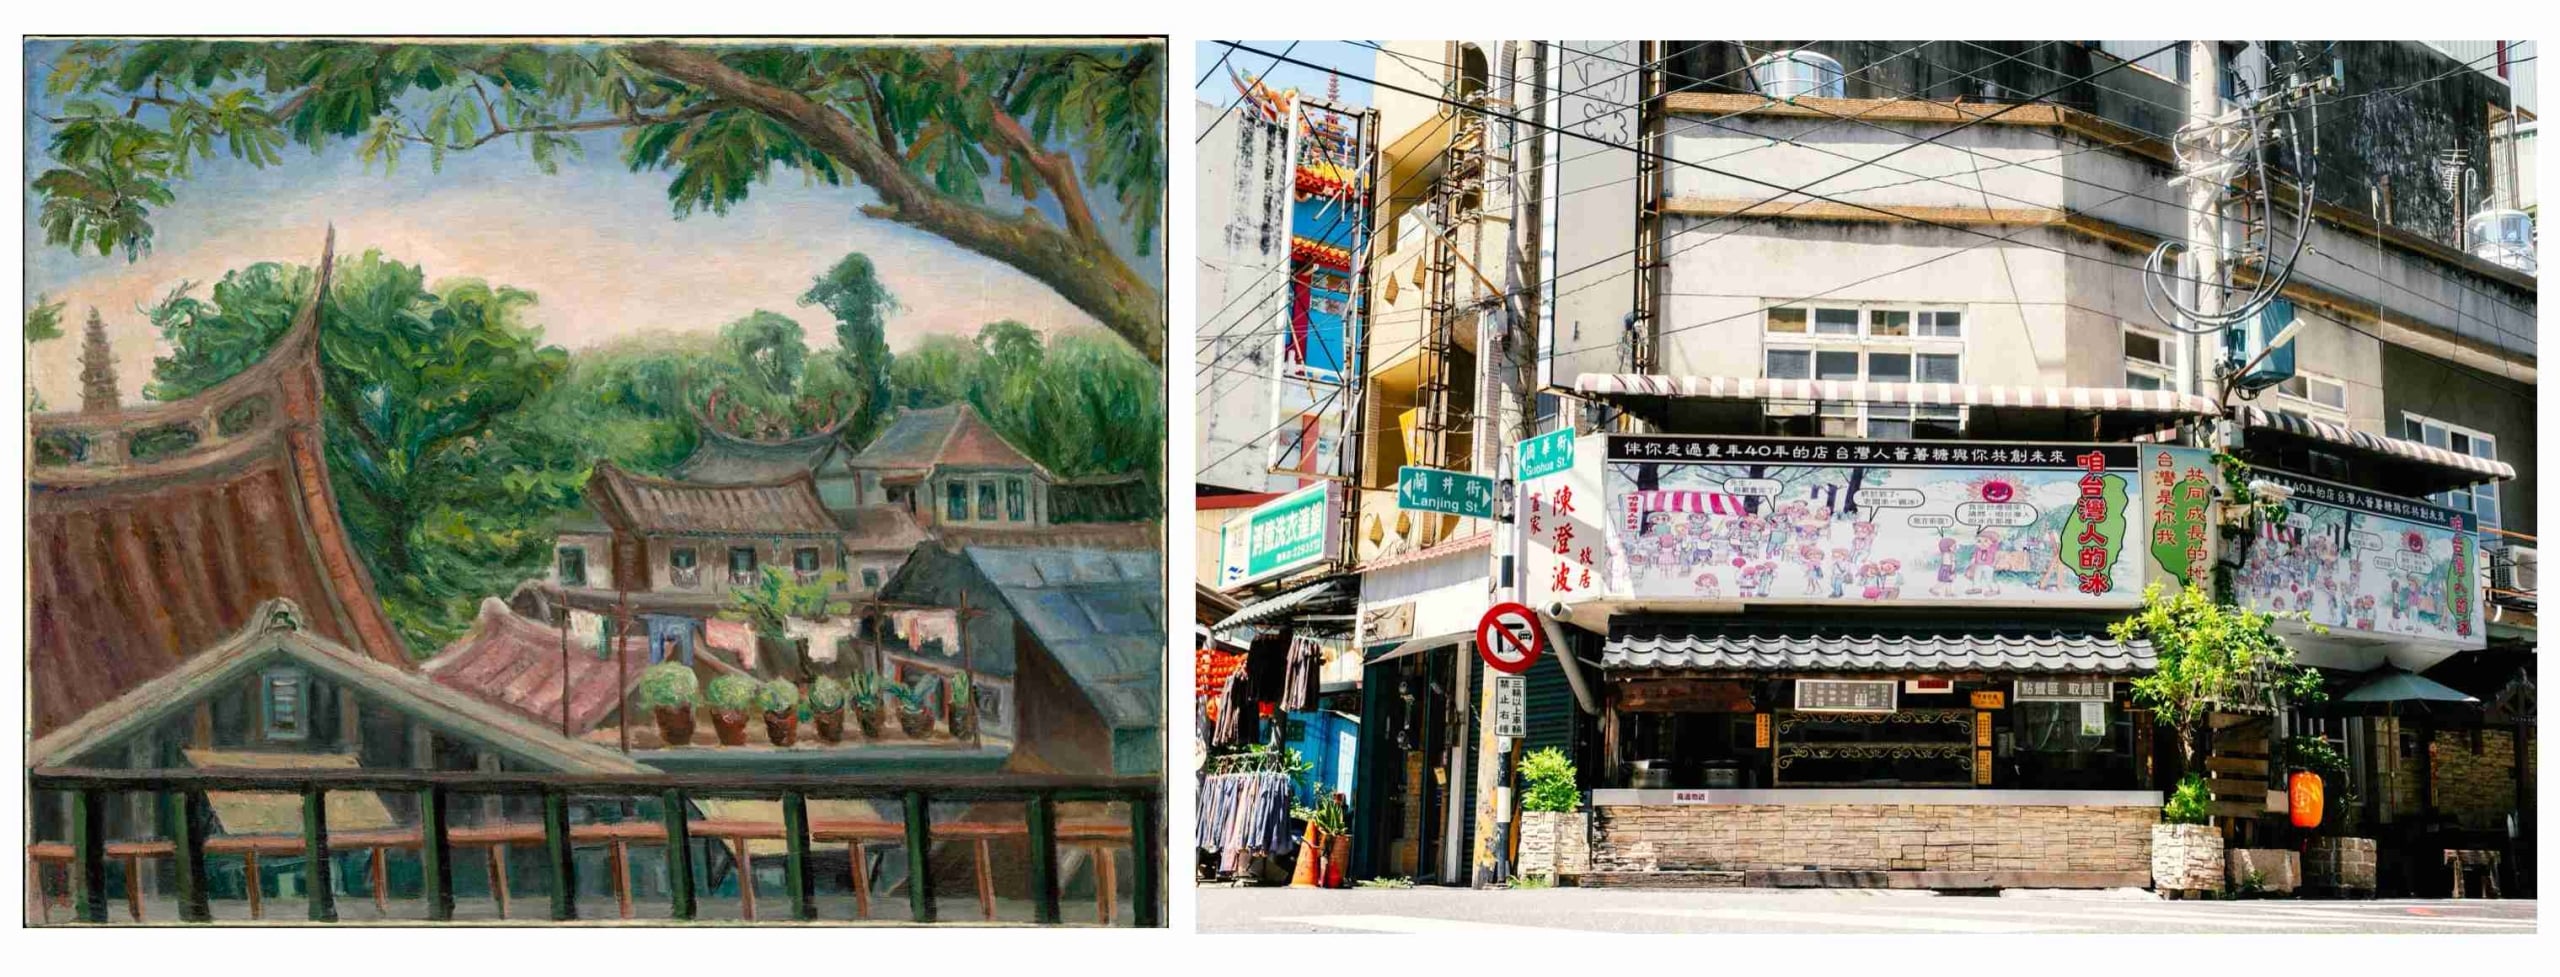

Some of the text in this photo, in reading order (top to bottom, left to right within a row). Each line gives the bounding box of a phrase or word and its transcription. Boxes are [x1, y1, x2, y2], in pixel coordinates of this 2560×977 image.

[1526, 434, 1567, 460] 國華街
[1413, 471, 1482, 498] 蘭井街
[1526, 461, 1554, 476] Guohua
[1412, 496, 1481, 513] Lanjing St.
[2155, 451, 2178, 545] 台灣是你我
[1551, 485, 1576, 593] 陳澄波
[2077, 450, 2109, 596] 咱台灣人的冰
[1578, 546, 1594, 589] 故居
